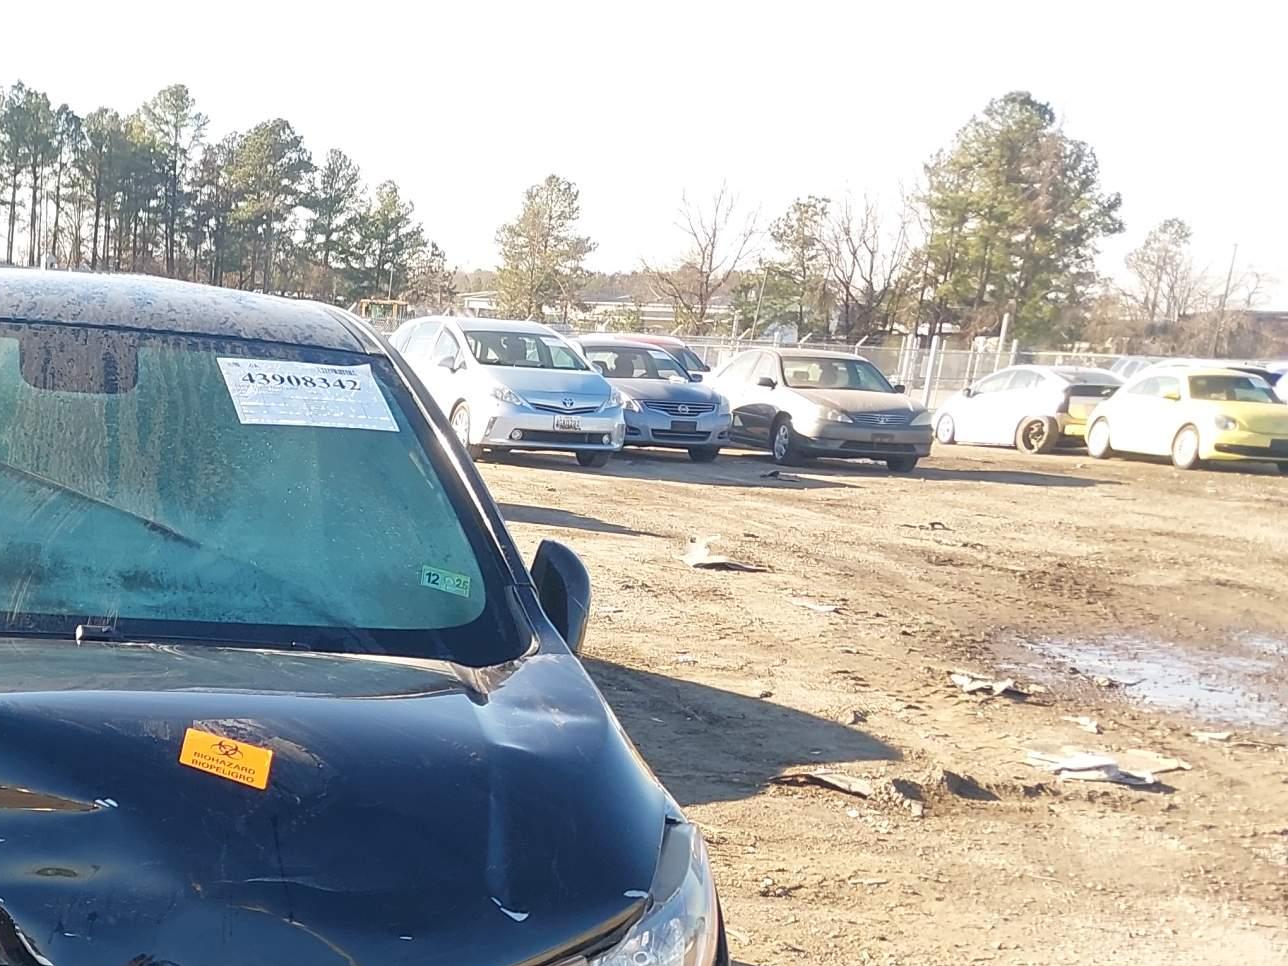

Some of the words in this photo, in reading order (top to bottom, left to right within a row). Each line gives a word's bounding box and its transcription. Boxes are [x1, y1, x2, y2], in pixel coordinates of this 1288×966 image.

[242, 372, 361, 391] 43908342
[425, 571, 440, 586] 12
[191, 758, 255, 783] BIOPELIGRO
[193, 751, 256, 776] BIOHAZARD
